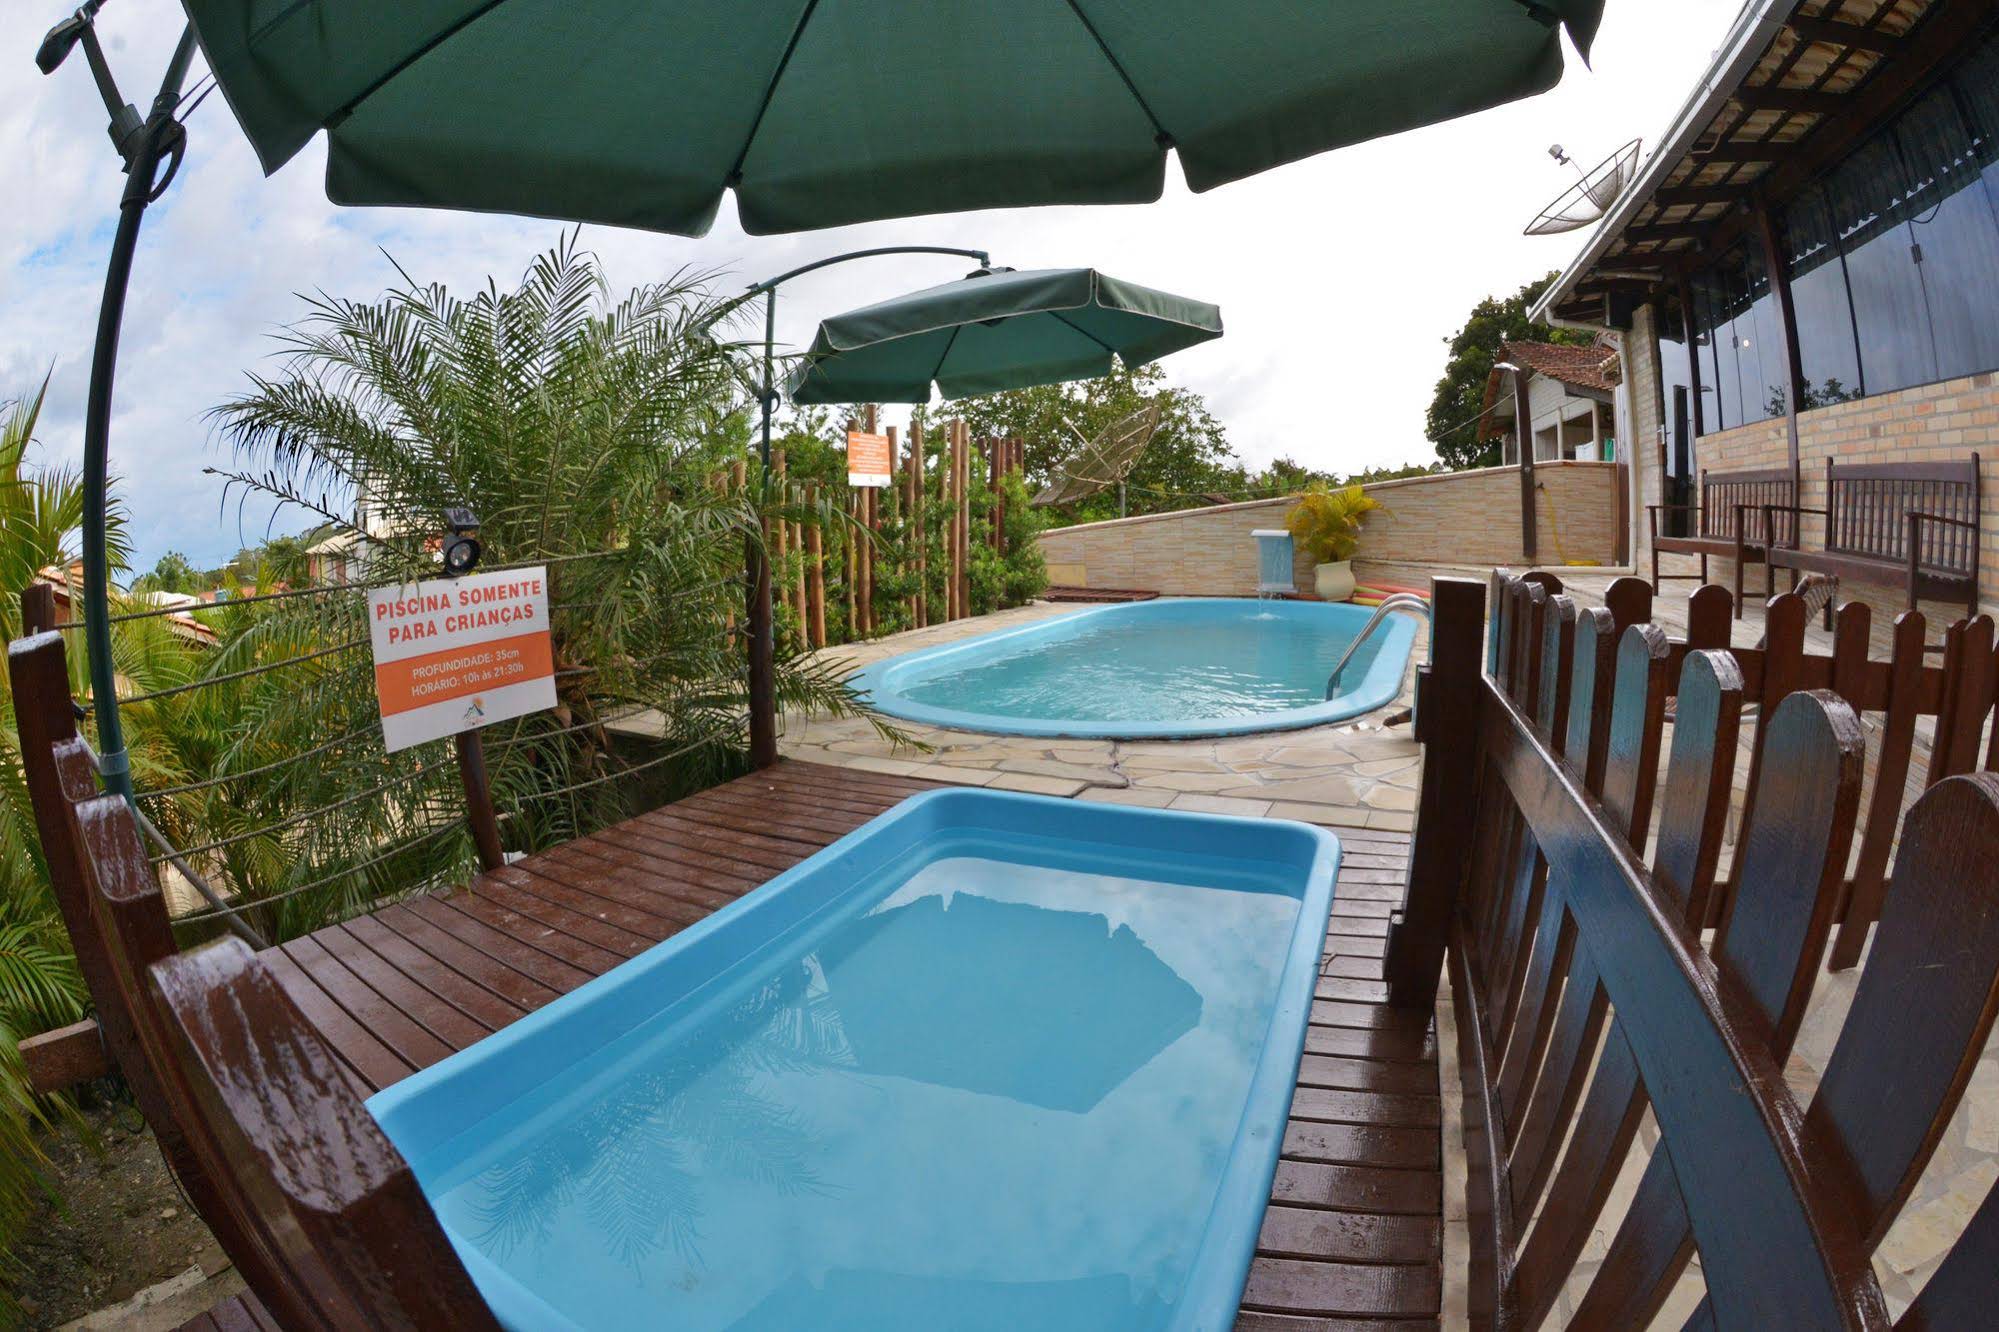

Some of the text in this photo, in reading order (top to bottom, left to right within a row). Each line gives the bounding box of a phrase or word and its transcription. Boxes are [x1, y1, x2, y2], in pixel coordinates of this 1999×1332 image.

[376, 580, 541, 621] PISCINA SOMENTE
[388, 604, 534, 645] PARA CRIANÇAS
[412, 648, 520, 679] PROFUNDIDADE: 35cm
[463, 671, 480, 685] 10h
[494, 662, 524, 678] 21:30h
